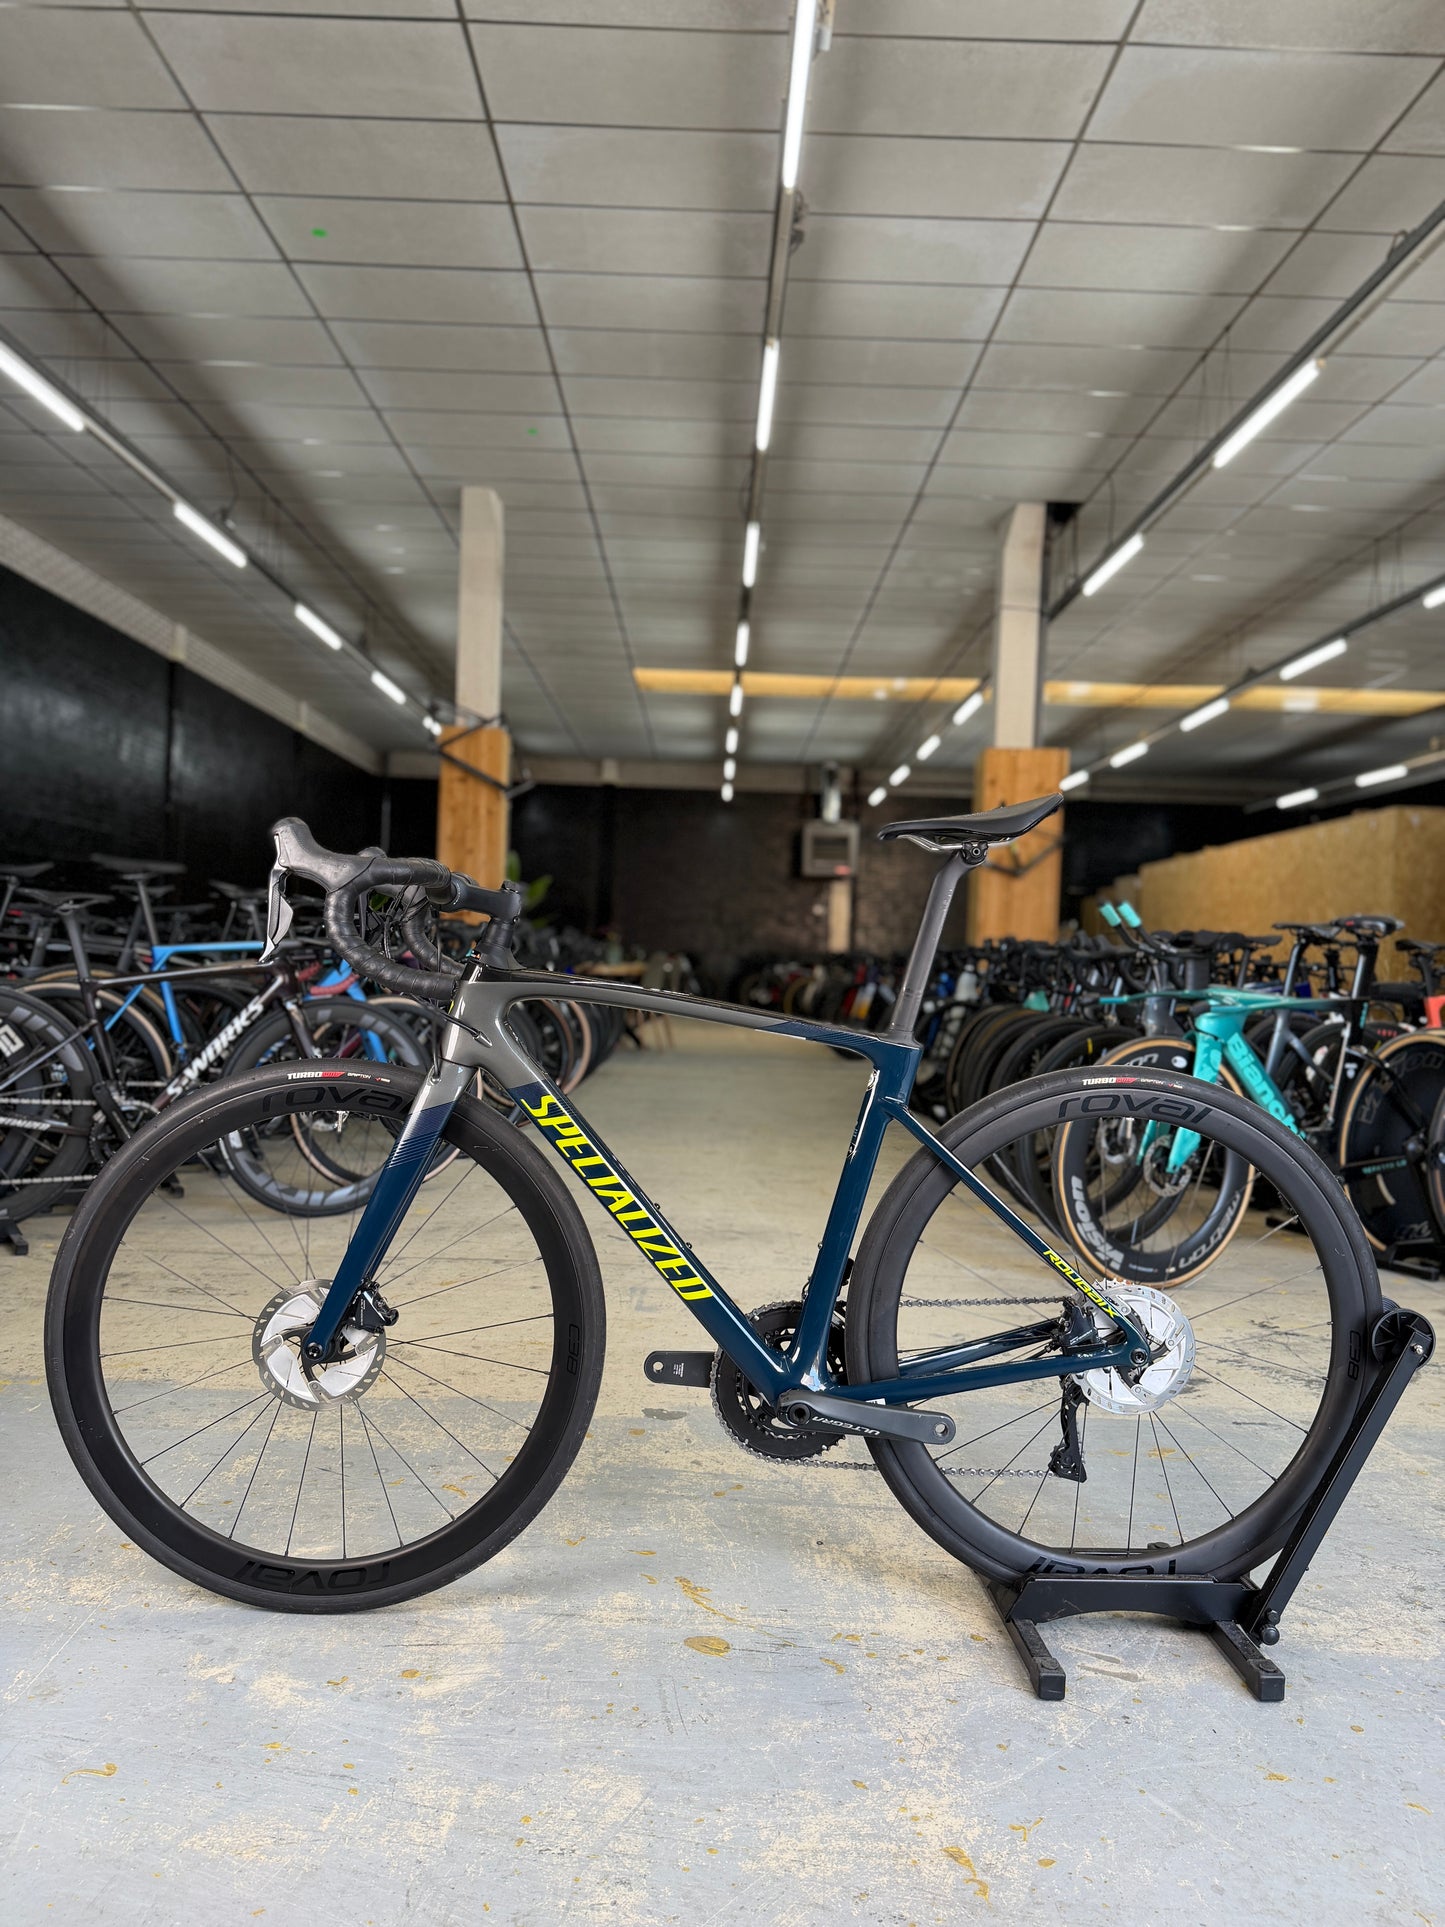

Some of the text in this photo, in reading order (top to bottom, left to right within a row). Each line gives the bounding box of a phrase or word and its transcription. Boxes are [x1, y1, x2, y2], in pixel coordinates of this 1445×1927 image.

[166, 996, 266, 1099] S-WORKS
[286, 1071, 323, 1080] TURBO
[1082, 1077, 1117, 1086] TURBO
[1058, 1094, 1213, 1124] roval
[521, 1094, 714, 1301] SPECIALIZED
[812, 1416, 881, 1436] ULTEGRA
